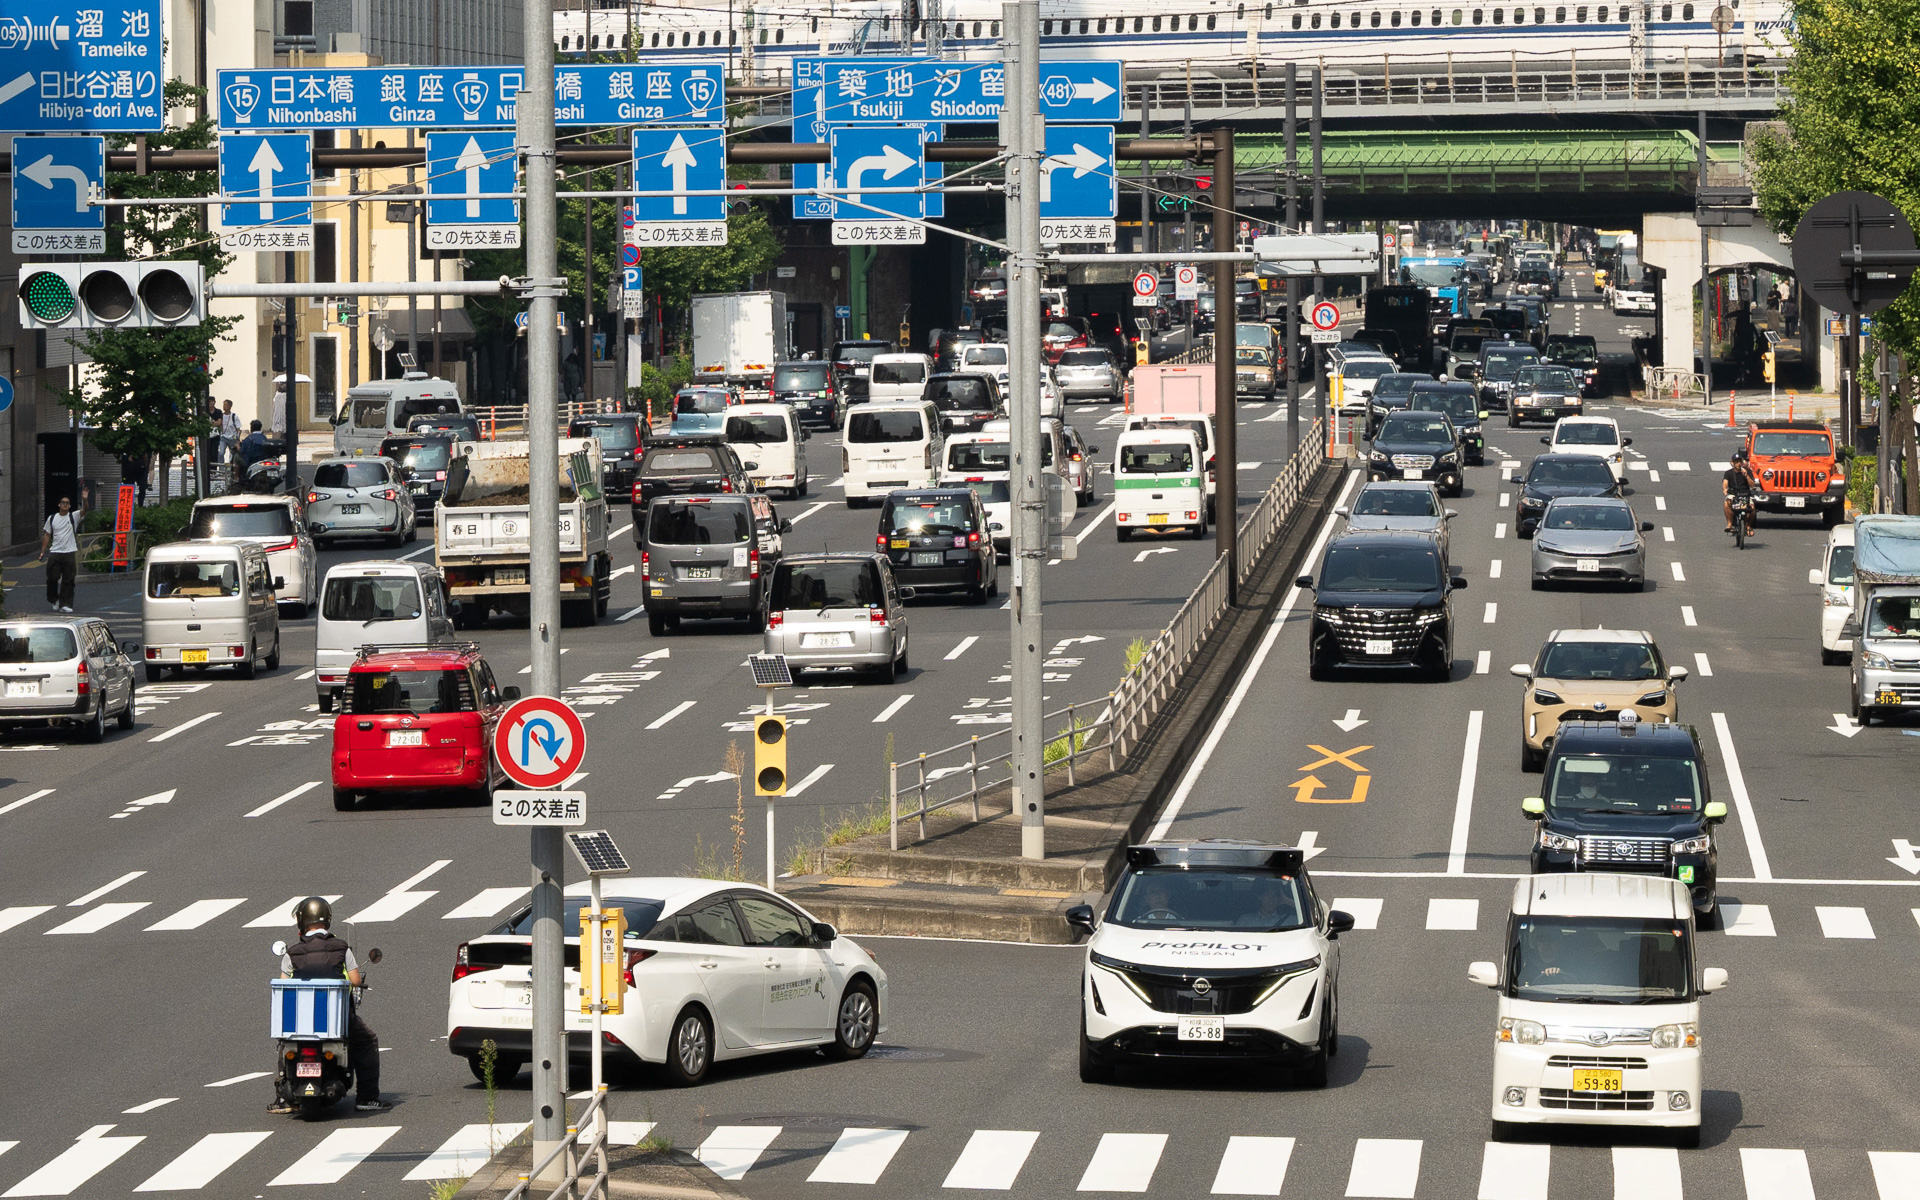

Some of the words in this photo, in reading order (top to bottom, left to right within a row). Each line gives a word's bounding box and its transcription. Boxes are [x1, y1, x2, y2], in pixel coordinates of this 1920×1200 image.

[76, 9, 150, 38] 溜池
[0, 26, 17, 40] 05
[78, 41, 148, 57] Tameike
[40, 70, 156, 98] 日比谷通り
[271, 75, 354, 104] 日本橋
[380, 73, 444, 103] 銀座
[608, 70, 672, 99] 銀座
[838, 69, 914, 97] 築地
[1046, 83, 1070, 98] 481
[232, 88, 253, 107] 15
[461, 84, 481, 104] 15
[689, 82, 710, 101] 15
[39, 102, 121, 120] Hibiya-dori
[127, 102, 157, 118] Ave.
[268, 107, 356, 123] Nihonbashi
[390, 105, 436, 122] Ginza
[618, 102, 664, 119] Ginza
[852, 100, 903, 119] Tsukiji
[814, 123, 826, 133] 15
[432, 230, 516, 245] この先交差点
[638, 227, 724, 242] この先交差点
[837, 225, 921, 240] この先交差点
[1041, 224, 1112, 238] の先交差点
[16, 234, 102, 250] この先交差点
[225, 232, 309, 248] この先交差点
[1880, 695, 1901, 705] 51-39
[397, 735, 421, 746] 72-00
[500, 799, 581, 819] この交差点
[1188, 1027, 1221, 1039] 65-88
[1584, 1078, 1619, 1091] 59-89
